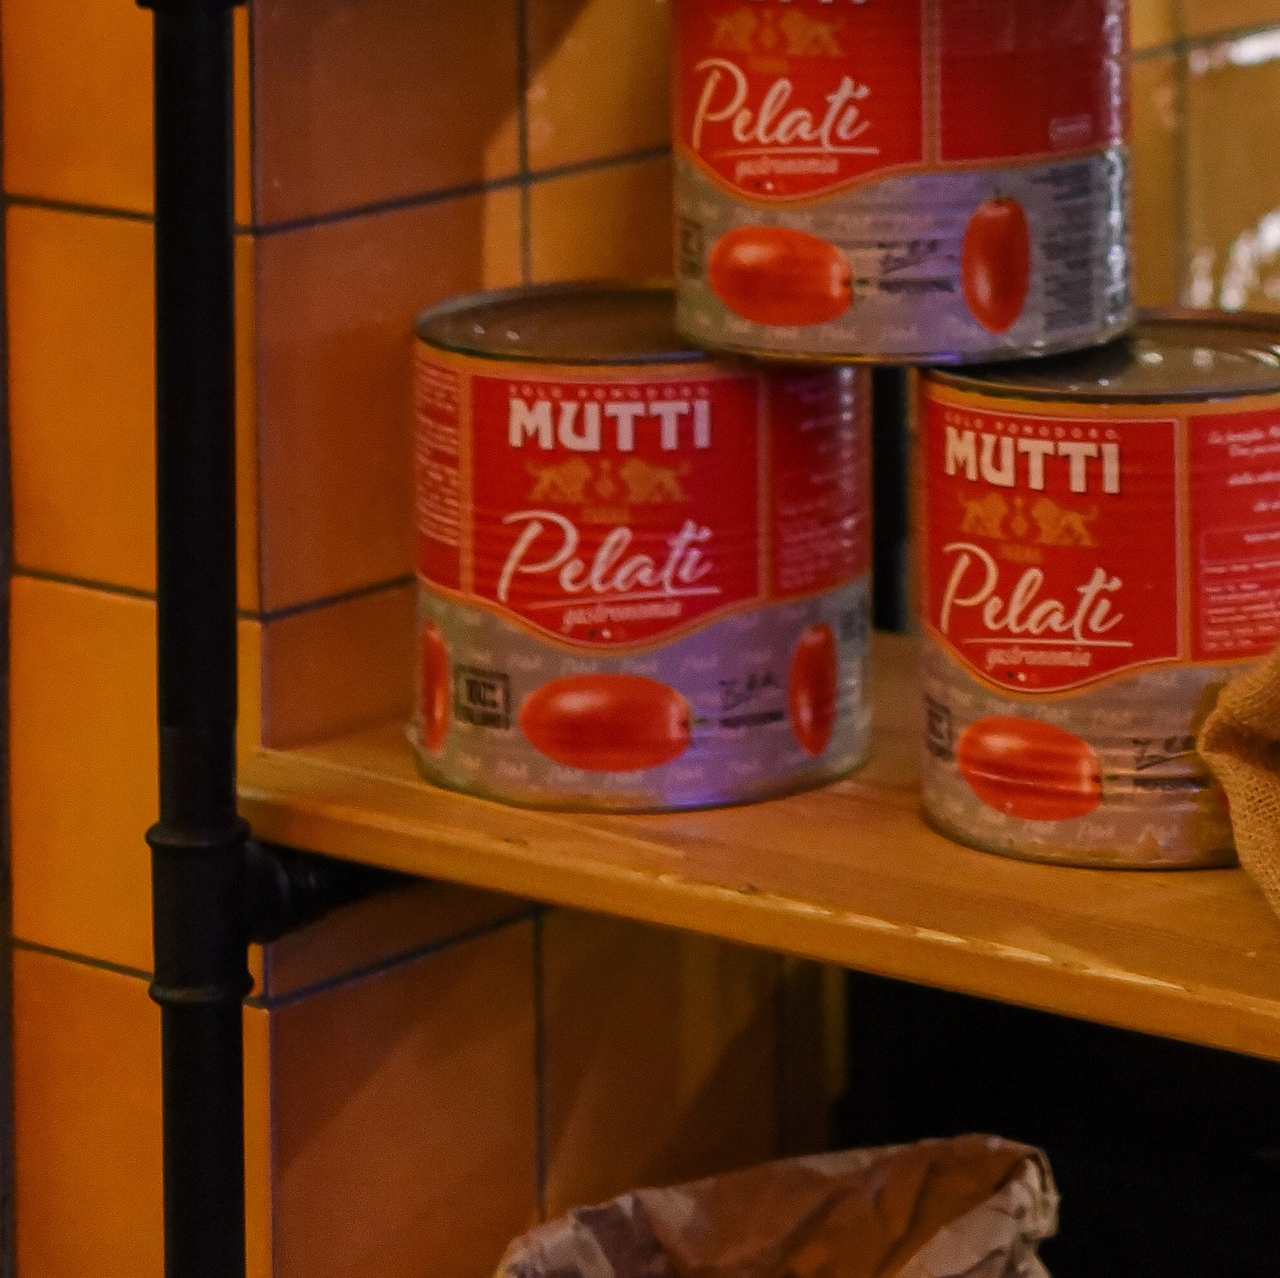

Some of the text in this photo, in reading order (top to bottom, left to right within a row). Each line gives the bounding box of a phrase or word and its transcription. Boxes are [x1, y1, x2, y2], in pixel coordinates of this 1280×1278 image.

[692, 57, 876, 152] Pelati
[508, 397, 712, 452] MUTTI
[944, 425, 1121, 494] MUTTI
[497, 509, 720, 603] Pelati
[940, 542, 1130, 644] Pelati
